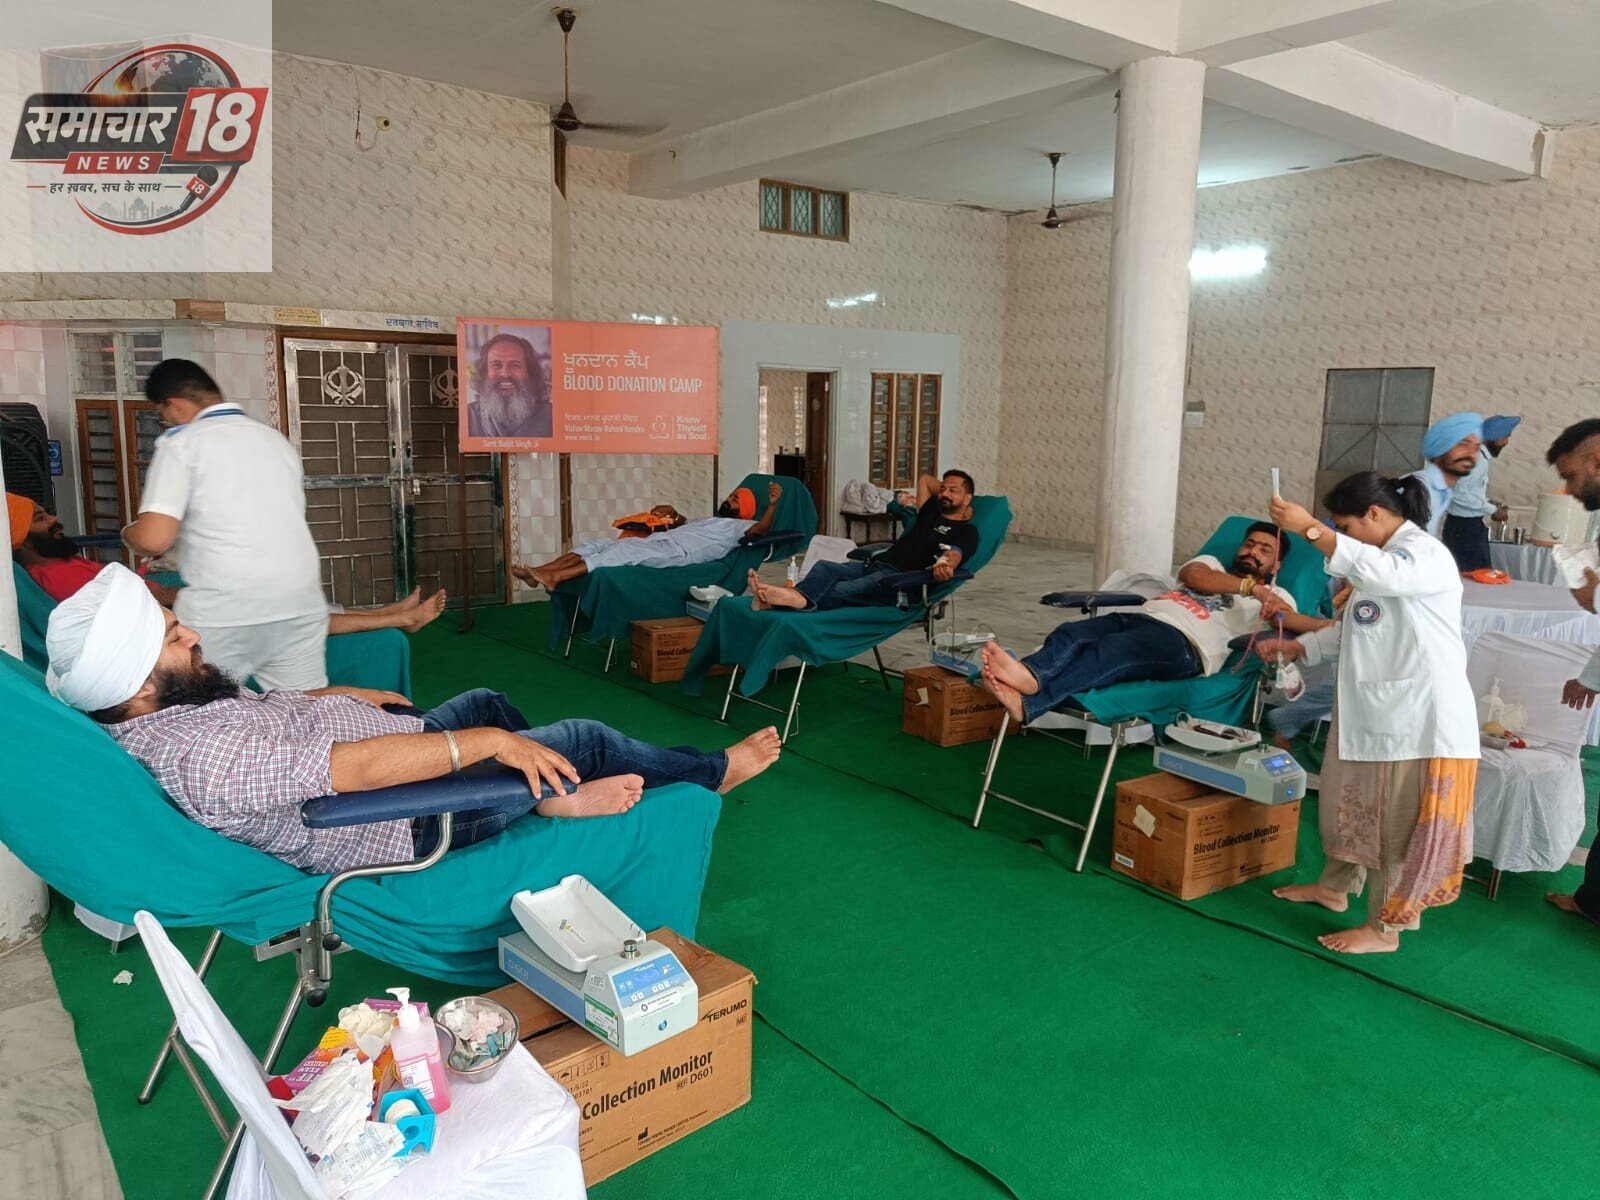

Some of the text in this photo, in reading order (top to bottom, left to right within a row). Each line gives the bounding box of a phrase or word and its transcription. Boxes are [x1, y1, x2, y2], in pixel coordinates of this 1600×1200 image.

[564, 375, 702, 393] BLOOD DONATION CAMP
[676, 416, 701, 425] Know
[1194, 839, 1216, 855] Blood
[1217, 831, 1252, 849] Collection
[1253, 824, 1280, 839] Monitor
[702, 999, 748, 1023] TERUMO
[582, 1050, 713, 1121] Collection Monitor
[690, 1065, 713, 1085] D601
